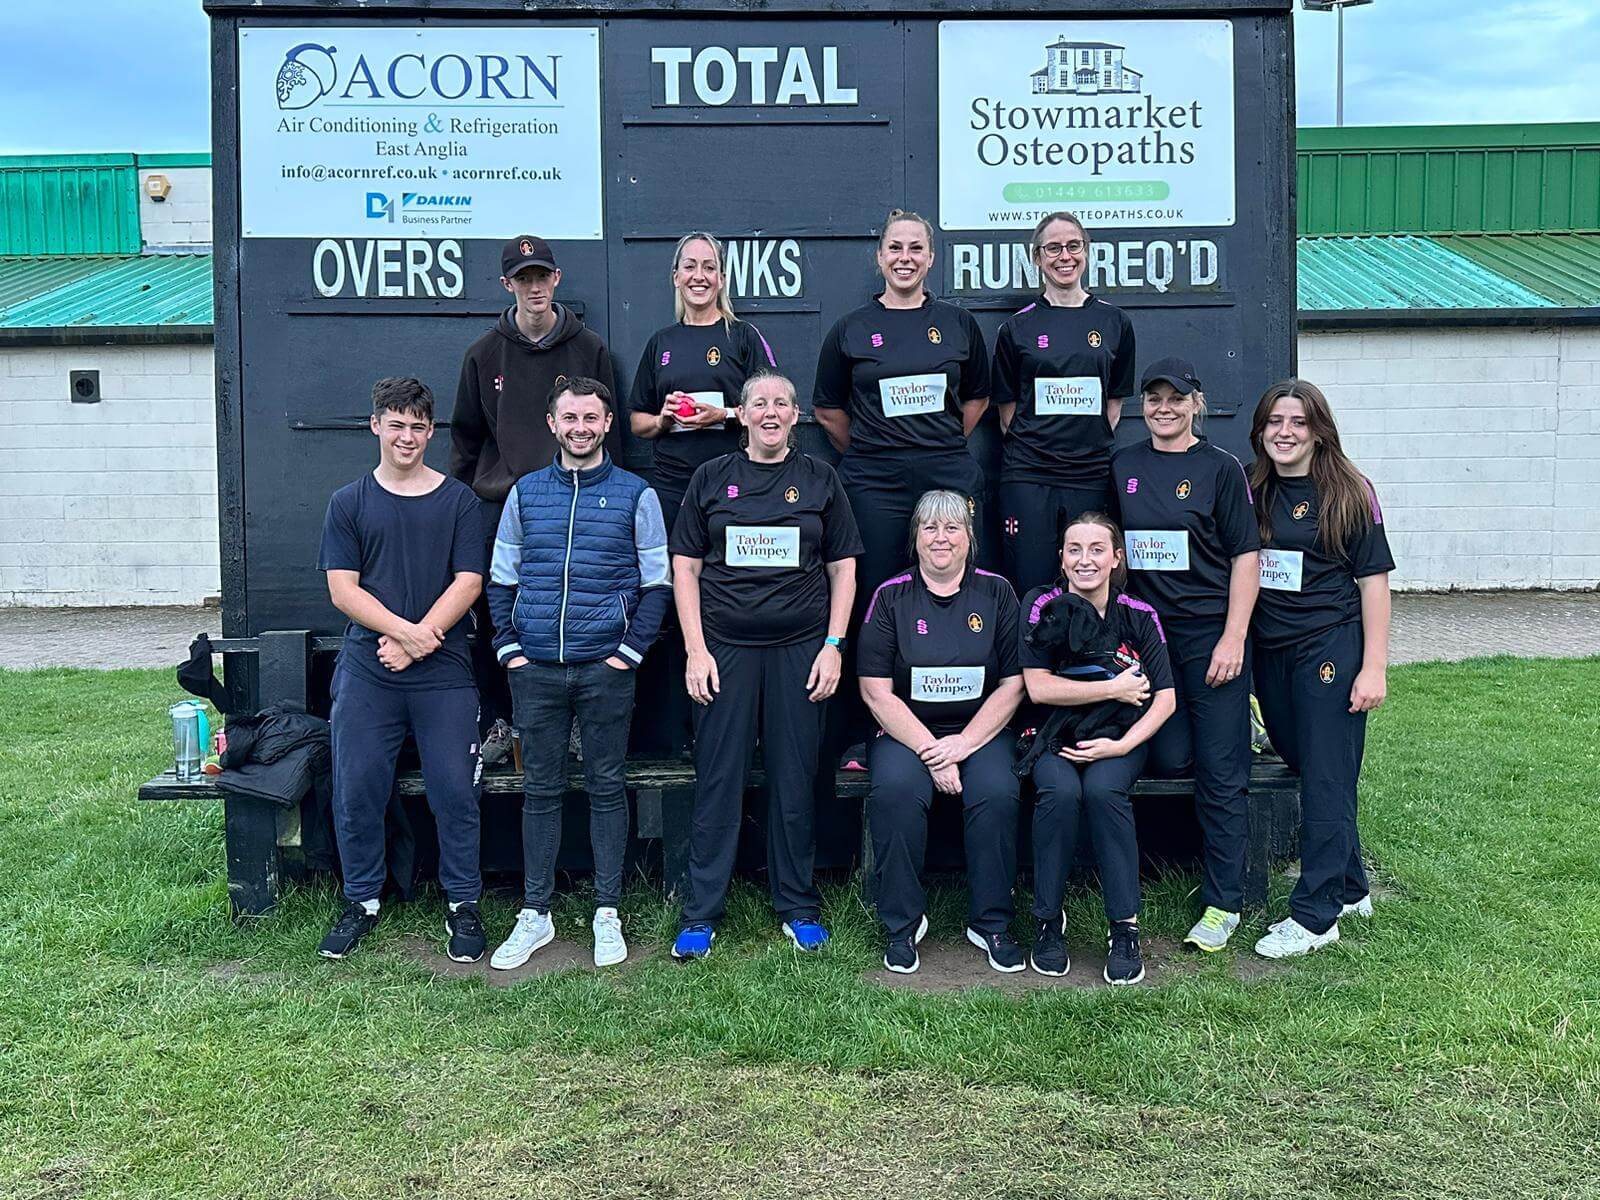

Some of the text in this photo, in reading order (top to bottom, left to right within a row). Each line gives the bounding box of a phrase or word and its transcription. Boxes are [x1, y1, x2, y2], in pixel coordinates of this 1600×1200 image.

[340, 53, 563, 100] ACORN
[651, 46, 858, 105] TOTAL
[970, 94, 1203, 130] Stowmarket
[277, 112, 559, 138] Air Conditioning & Refrigeration
[376, 141, 468, 160] East Anglia
[977, 130, 1195, 175] Osteopaths
[281, 165, 562, 182] info@acornref.co.uk acornref.co.uk
[1035, 187, 1086, 199] 01449
[416, 195, 472, 206] DAIKIN
[402, 215, 473, 225] Business Partner
[988, 209, 1184, 222] WWW.STOSTEOPATHS.CO.UK
[313, 239, 464, 298] OVERS
[953, 240, 1219, 292] RUN REQ'D
[889, 382, 928, 396] Taylor
[1044, 383, 1084, 397] Taylor
[890, 392, 938, 407] Wimpey
[1045, 394, 1096, 407] Wimpey
[735, 533, 777, 546] Taylor
[1131, 537, 1166, 549] Taylor
[736, 545, 790, 559] Wimpey
[1131, 549, 1179, 562] Wimpey
[922, 673, 962, 685] Taylor
[921, 684, 975, 696] Wimpey
